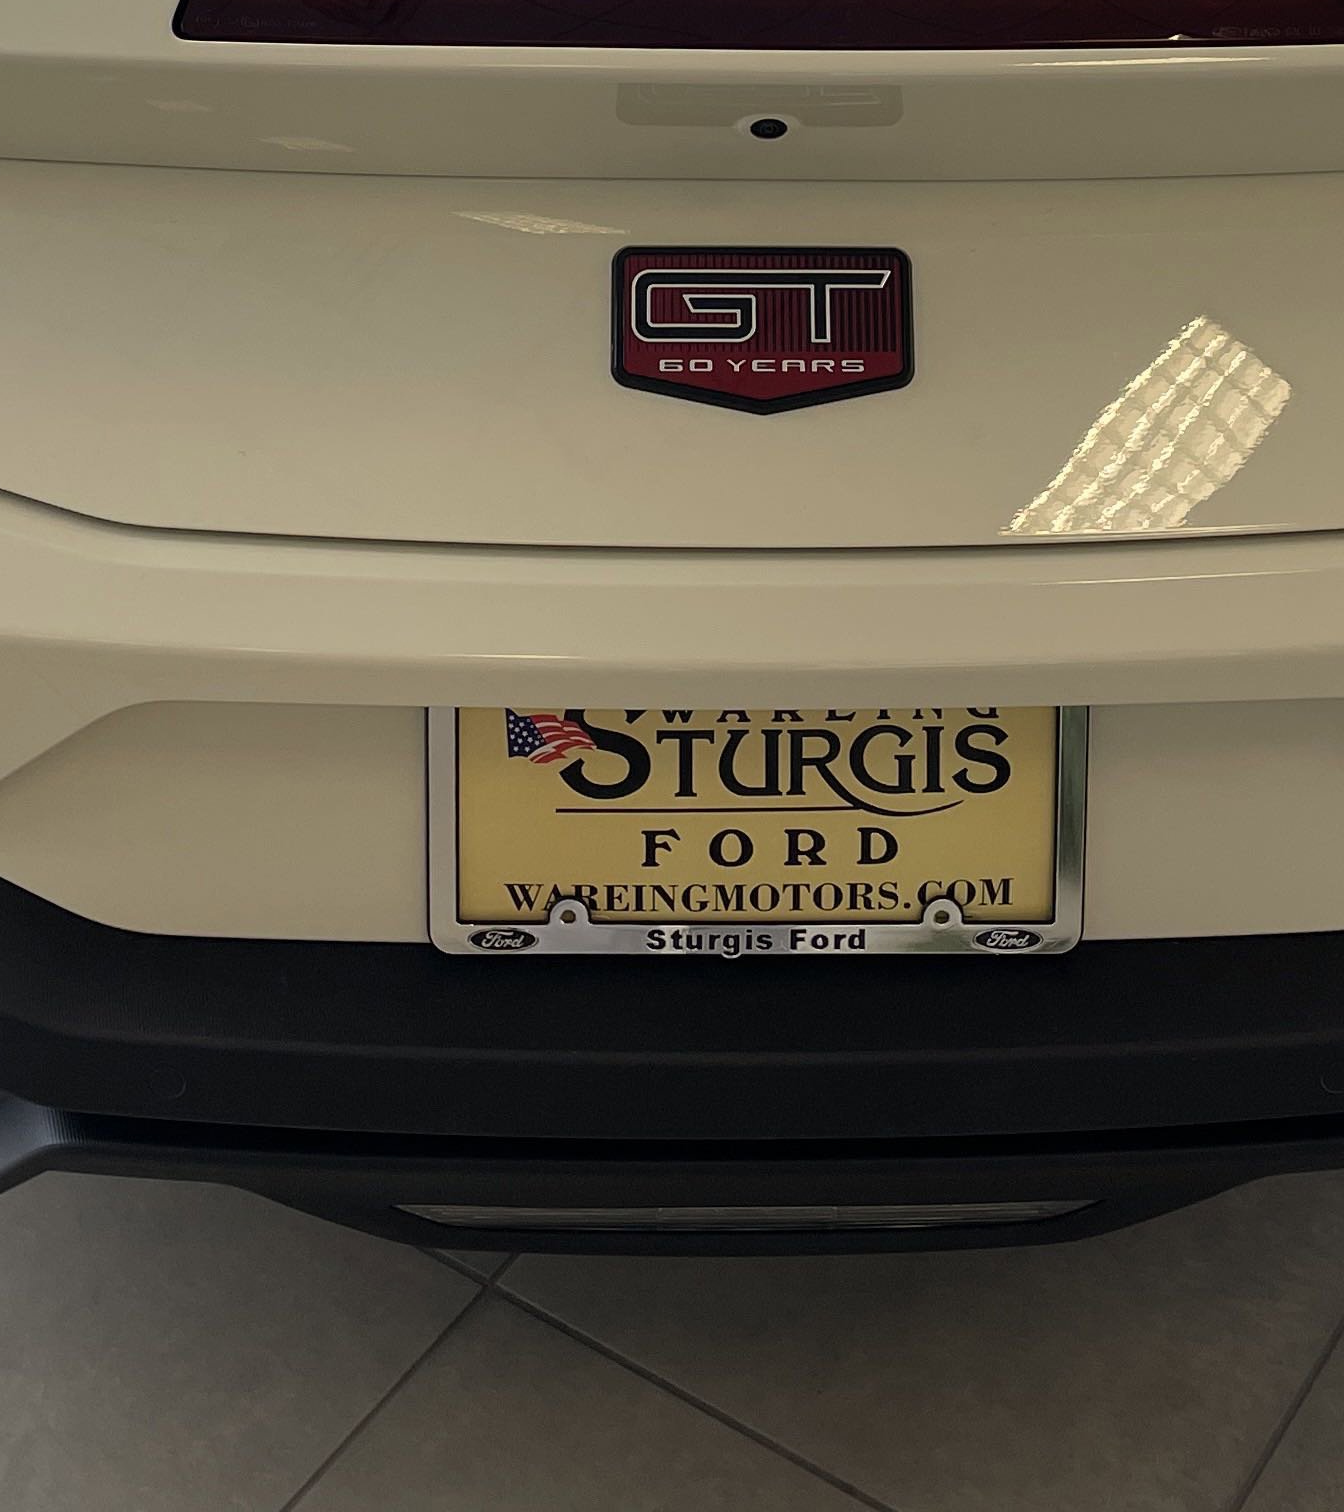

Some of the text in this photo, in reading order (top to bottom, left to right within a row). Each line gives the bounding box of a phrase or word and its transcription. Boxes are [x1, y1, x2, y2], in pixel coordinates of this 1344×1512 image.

[631, 268, 892, 343] GT
[658, 358, 865, 373] 60 YEARS
[558, 708, 1012, 817] STURGIS
[640, 827, 899, 868] FORD
[503, 877, 1014, 913] WAREINGMOTORS.COM
[480, 930, 526, 950] Ford
[646, 928, 866, 957] Sturgis Ford
[986, 930, 1030, 949] Ford
